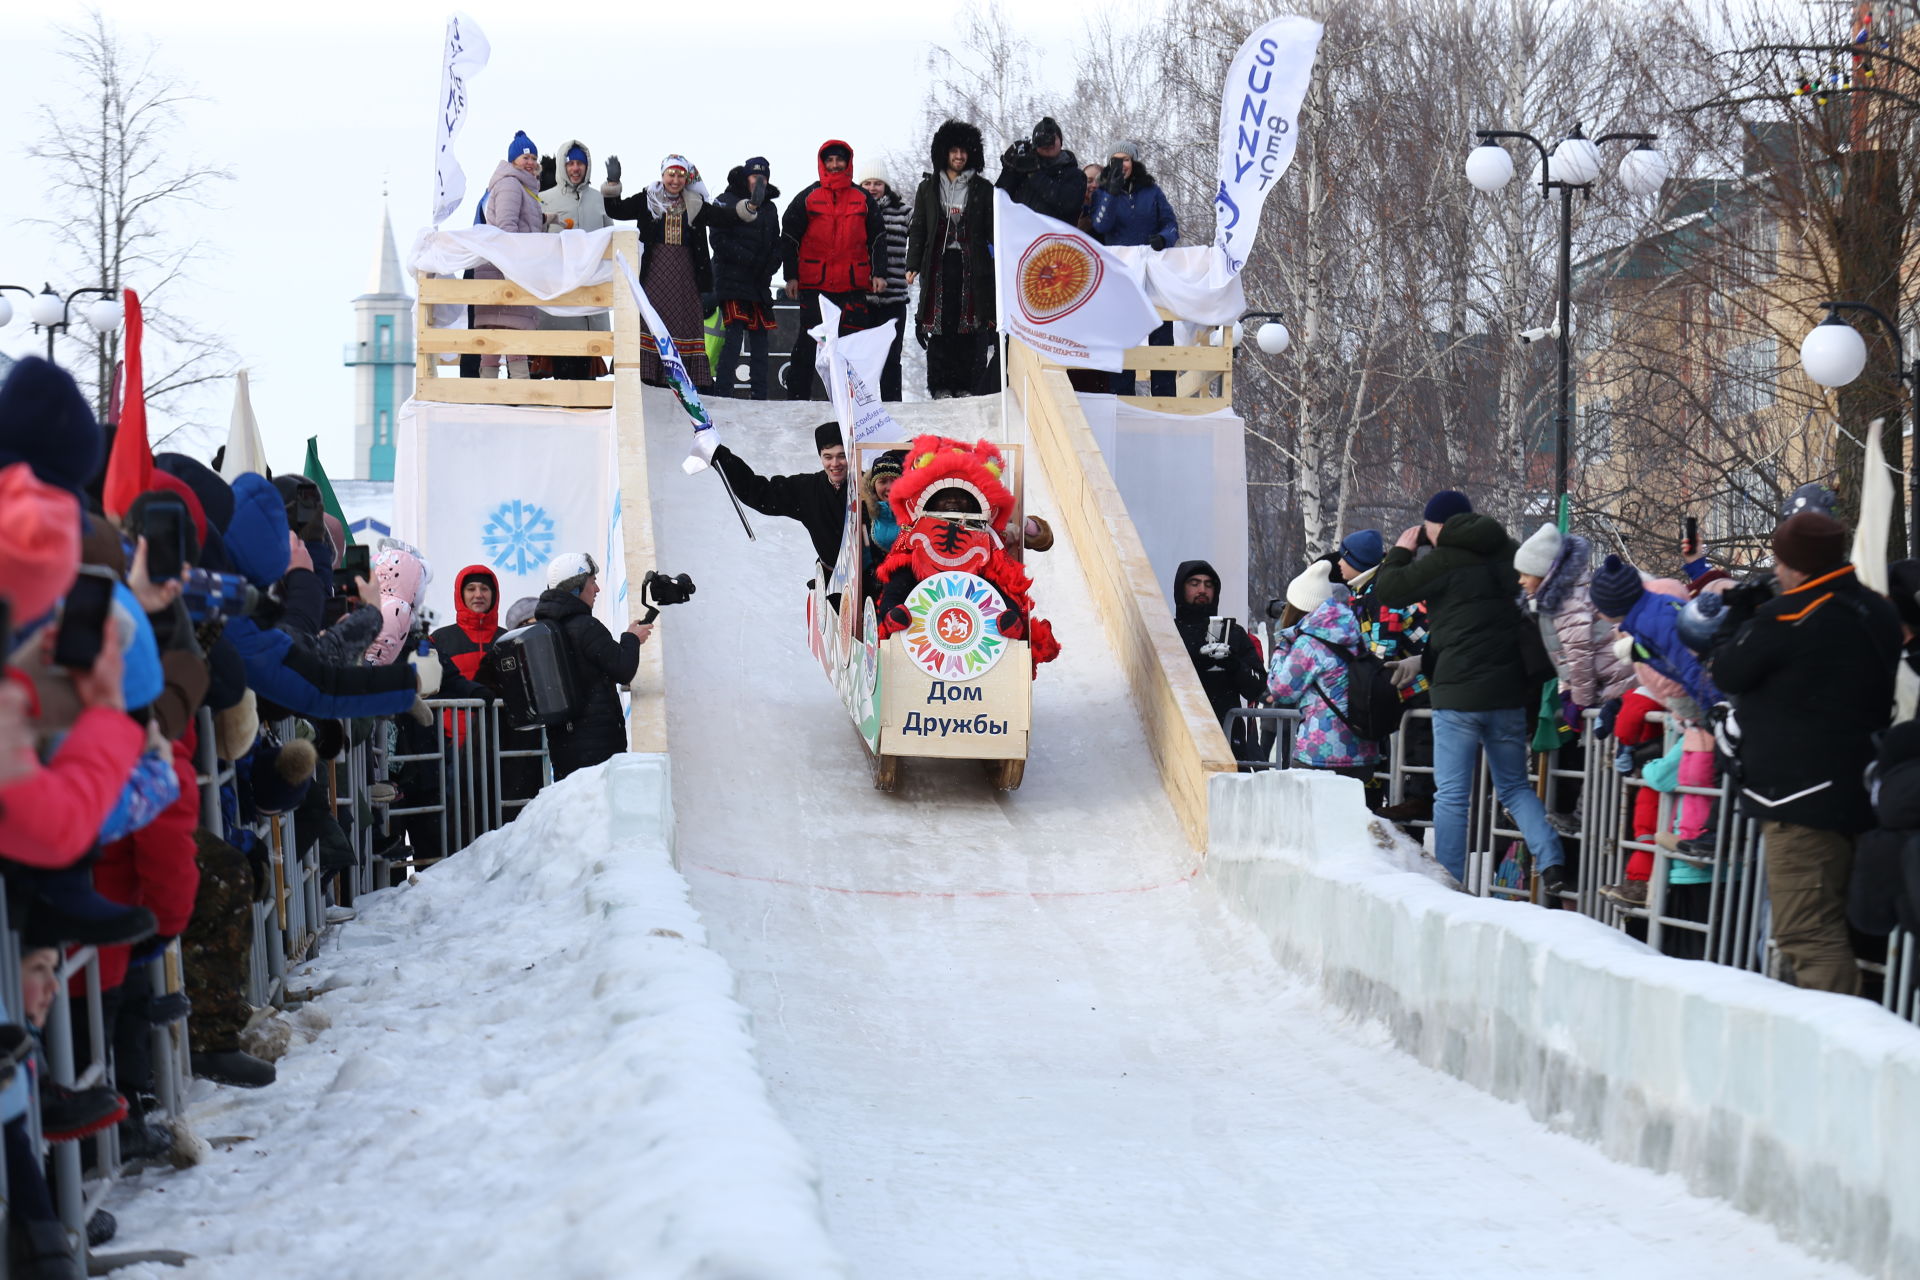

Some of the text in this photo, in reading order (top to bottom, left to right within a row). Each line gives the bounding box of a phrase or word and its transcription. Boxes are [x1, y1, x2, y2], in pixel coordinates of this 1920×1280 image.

[1235, 38, 1278, 183] SUNNY
[1259, 115, 1289, 191] ФЕСТ
[927, 681, 982, 704] Дом
[903, 711, 1008, 737] Дружбы
